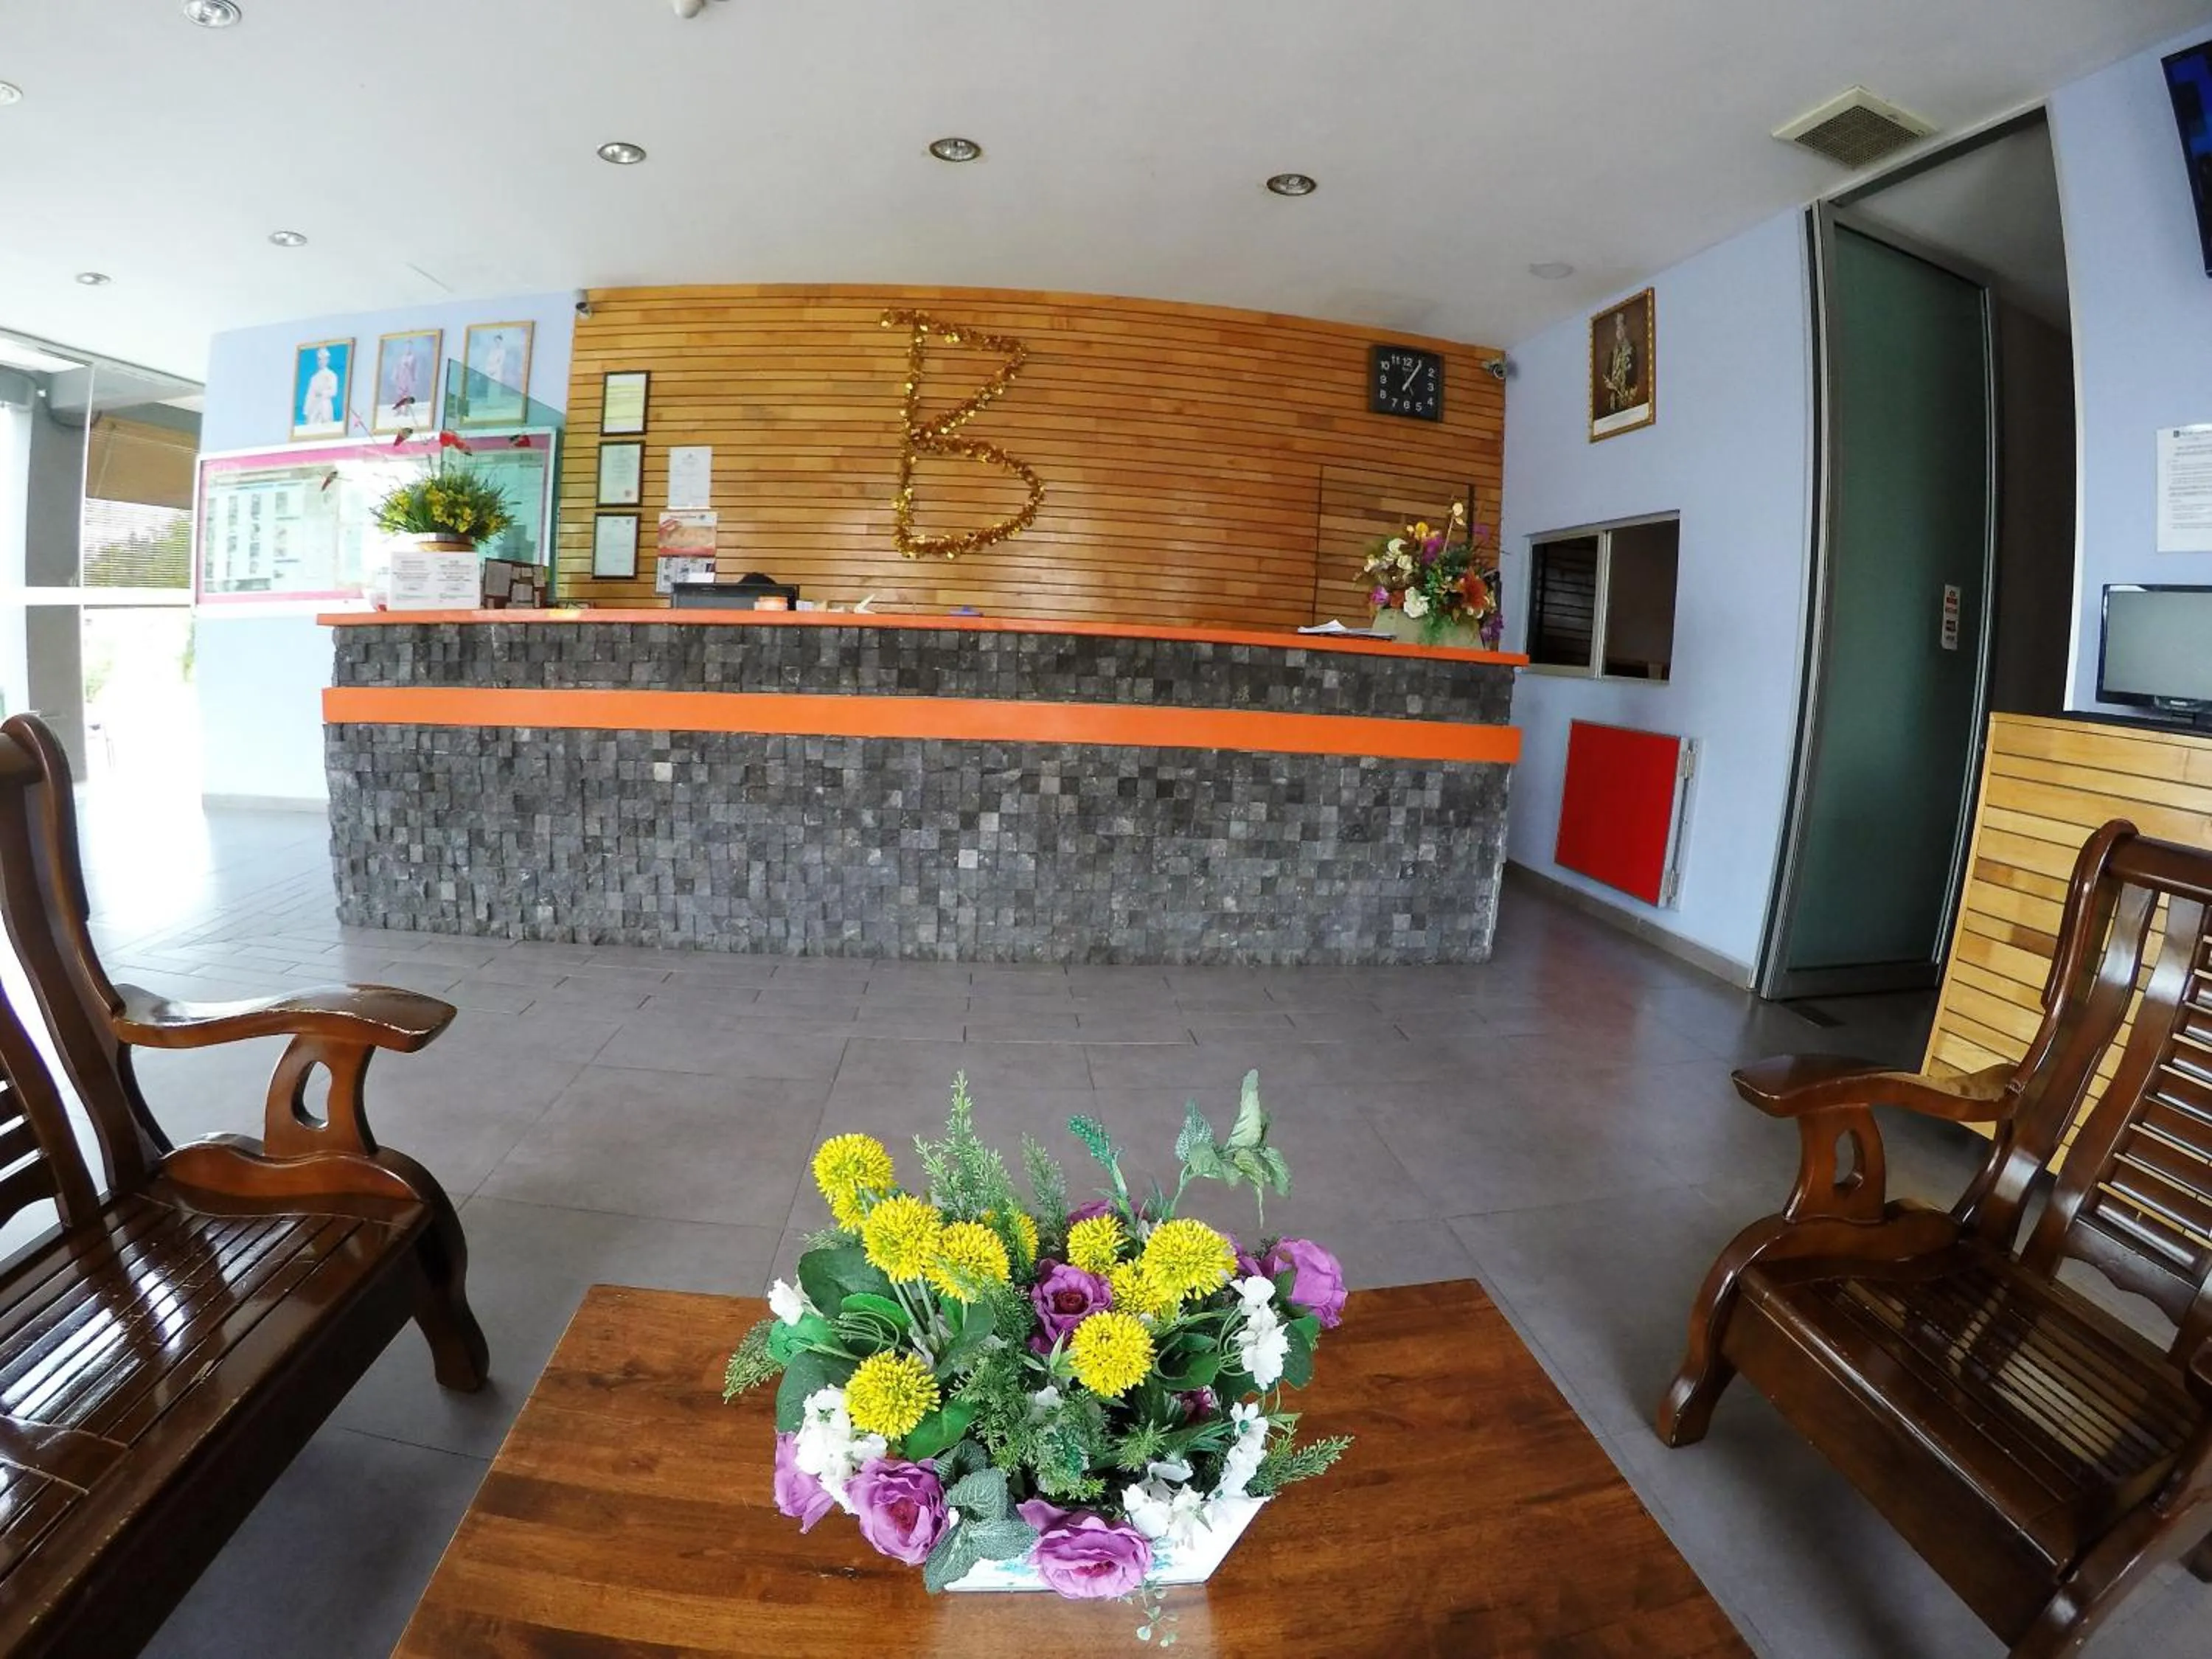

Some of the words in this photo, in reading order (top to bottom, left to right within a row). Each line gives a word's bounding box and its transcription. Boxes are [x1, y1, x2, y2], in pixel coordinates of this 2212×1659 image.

[1391, 354, 1400, 364] 11
[1402, 358, 1413, 367] 12
[1380, 361, 1390, 370] 10
[1427, 368, 1435, 378] 2
[1427, 383, 1434, 392] 3
[1391, 398, 1398, 408] 7
[1403, 400, 1411, 410] 6
[1427, 397, 1433, 406] 4
[1416, 402, 1422, 411] 5
[881, 307, 1043, 557] B
